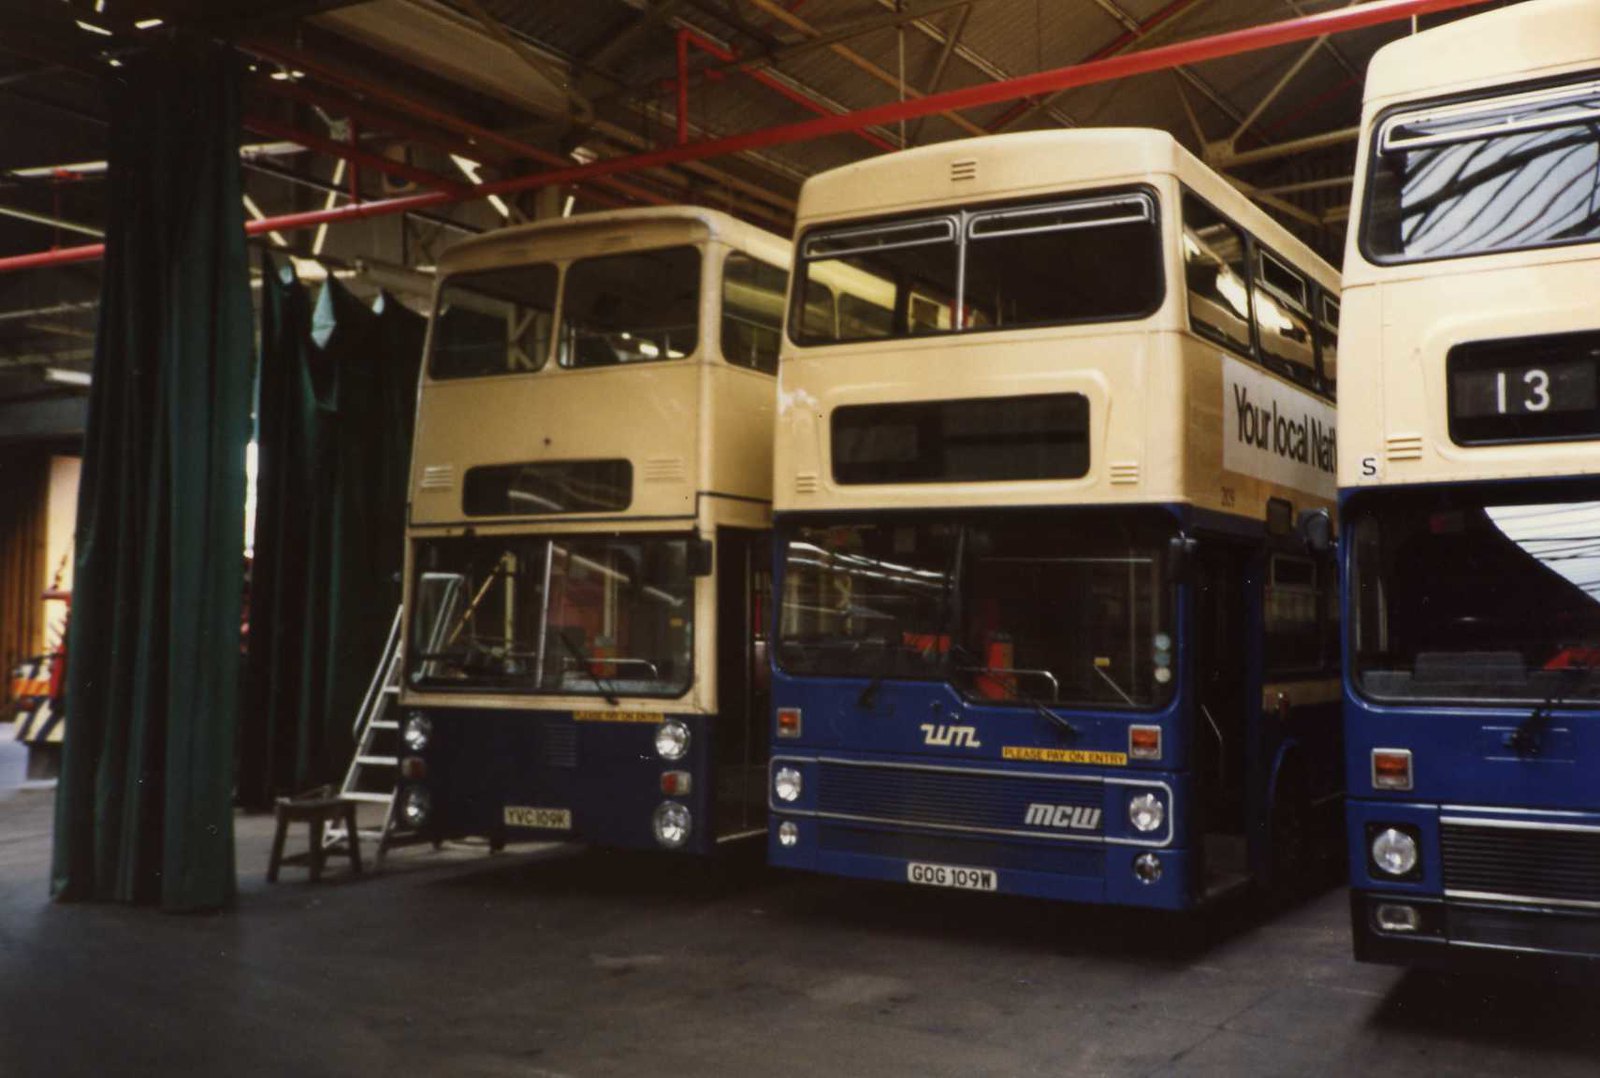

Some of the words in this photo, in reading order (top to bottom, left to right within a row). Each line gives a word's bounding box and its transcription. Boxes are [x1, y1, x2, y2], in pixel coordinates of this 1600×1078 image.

[1497, 369, 1550, 414] 13
[1233, 382, 1271, 450] Your
[1273, 400, 1309, 465] local
[1361, 457, 1378, 476] S
[1003, 747, 1042, 759] PLEASE
[1046, 749, 1066, 761] PAY
[1068, 751, 1086, 762] ON
[1088, 752, 1125, 765] ENTRY
[911, 864, 947, 885] GOG
[950, 869, 992, 889] 109W
